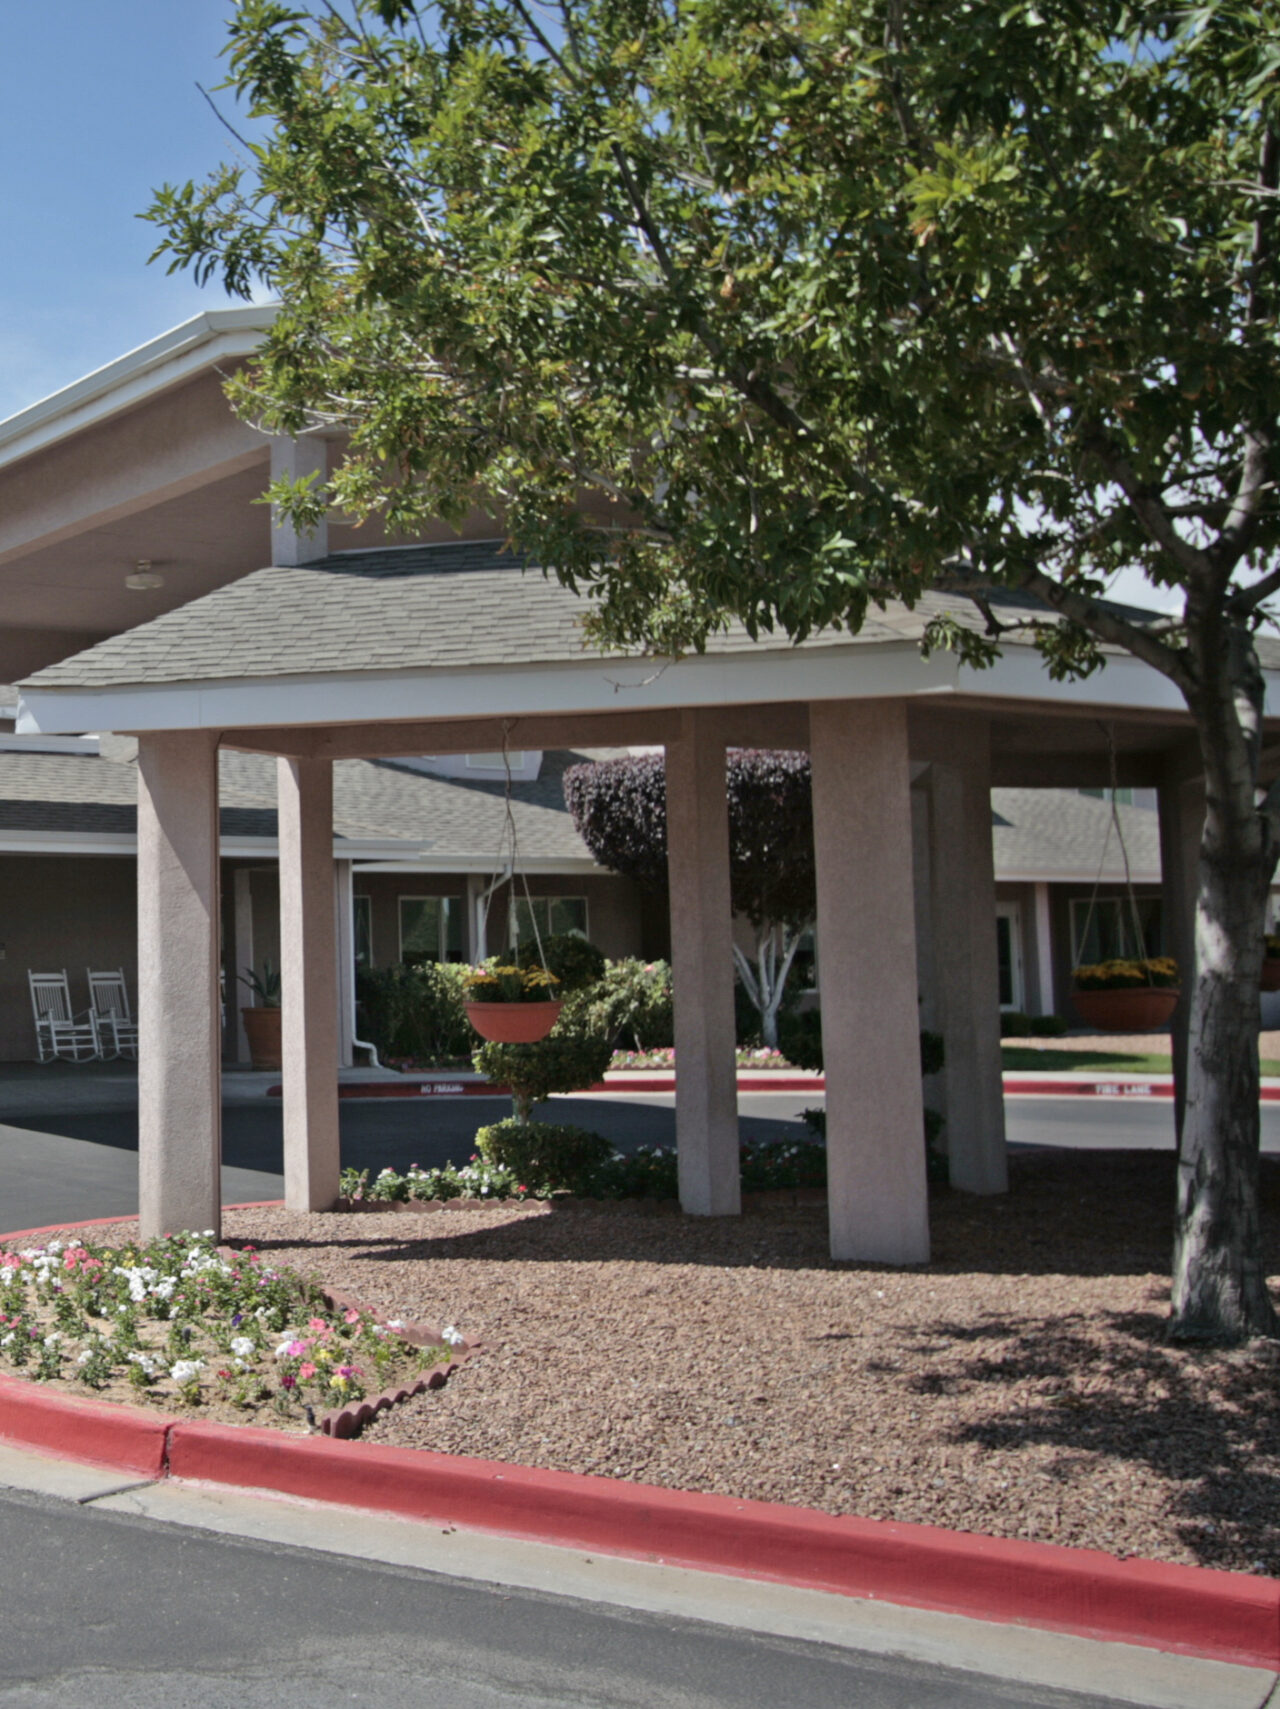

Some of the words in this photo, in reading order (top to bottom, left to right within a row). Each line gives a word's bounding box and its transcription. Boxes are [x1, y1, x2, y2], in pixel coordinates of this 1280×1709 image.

[420, 1084, 431, 1093] NO
[1095, 1084, 1119, 1094] FIRE
[1123, 1084, 1151, 1095] LANE
